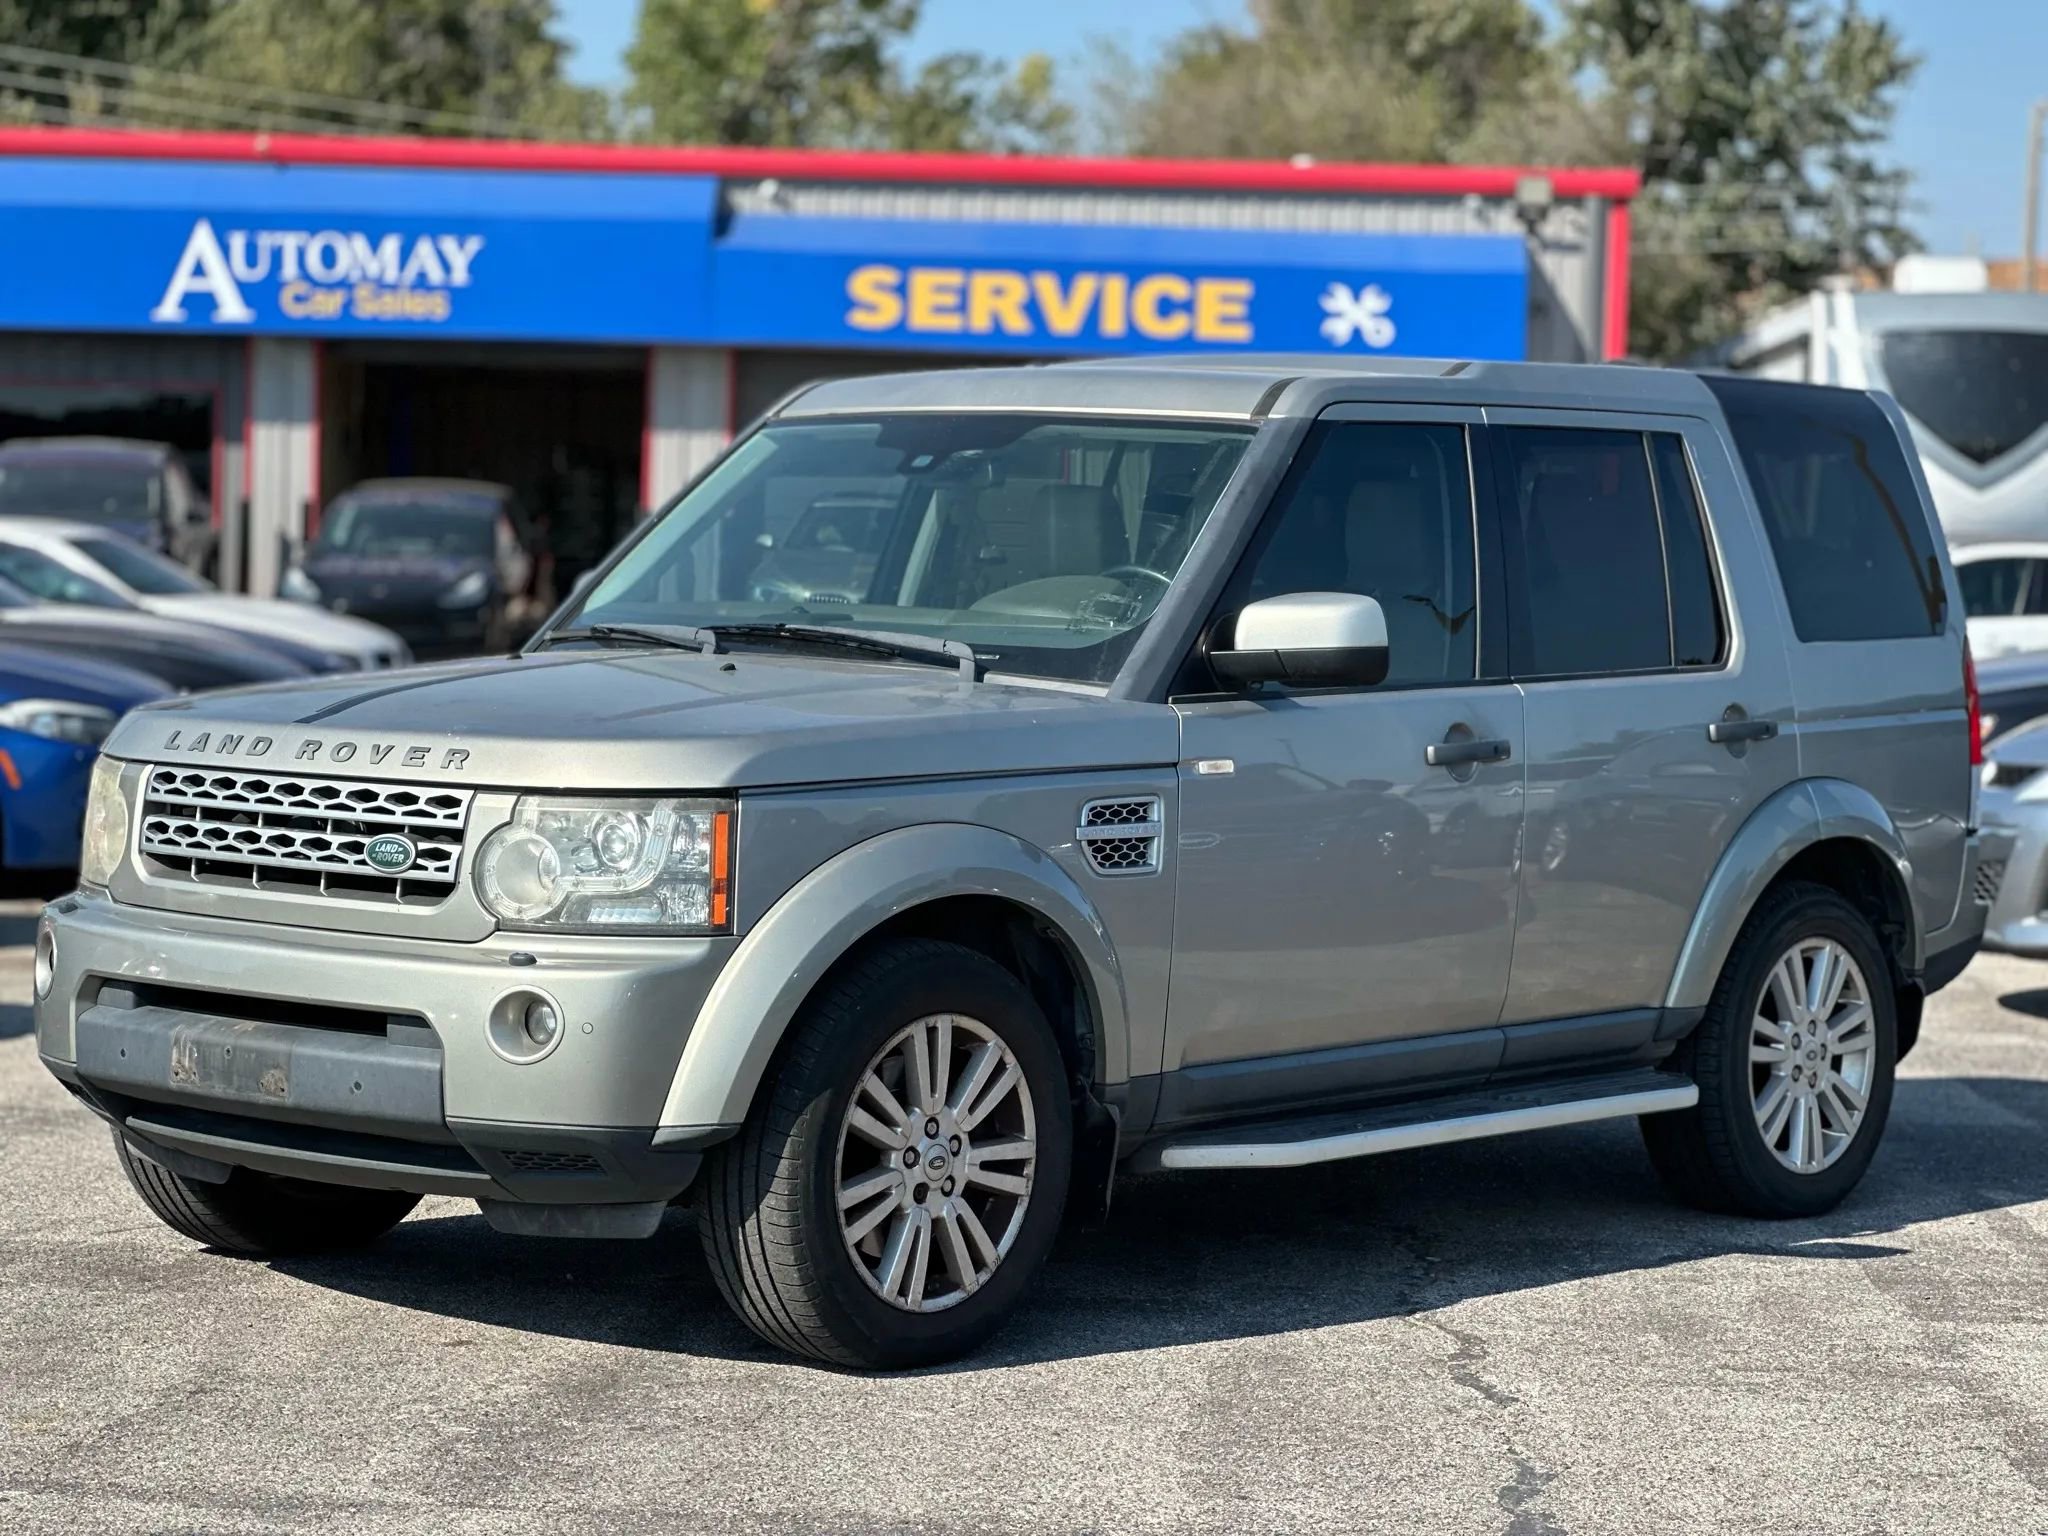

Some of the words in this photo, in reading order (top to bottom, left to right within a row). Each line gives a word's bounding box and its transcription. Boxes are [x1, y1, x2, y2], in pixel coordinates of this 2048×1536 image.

[279, 279, 346, 319] Car
[352, 281, 452, 322] Sales
[846, 264, 1254, 342] SERVICE
[163, 730, 273, 757] LAND
[294, 739, 470, 770] ROVER
[376, 852, 404, 864] ROVER
